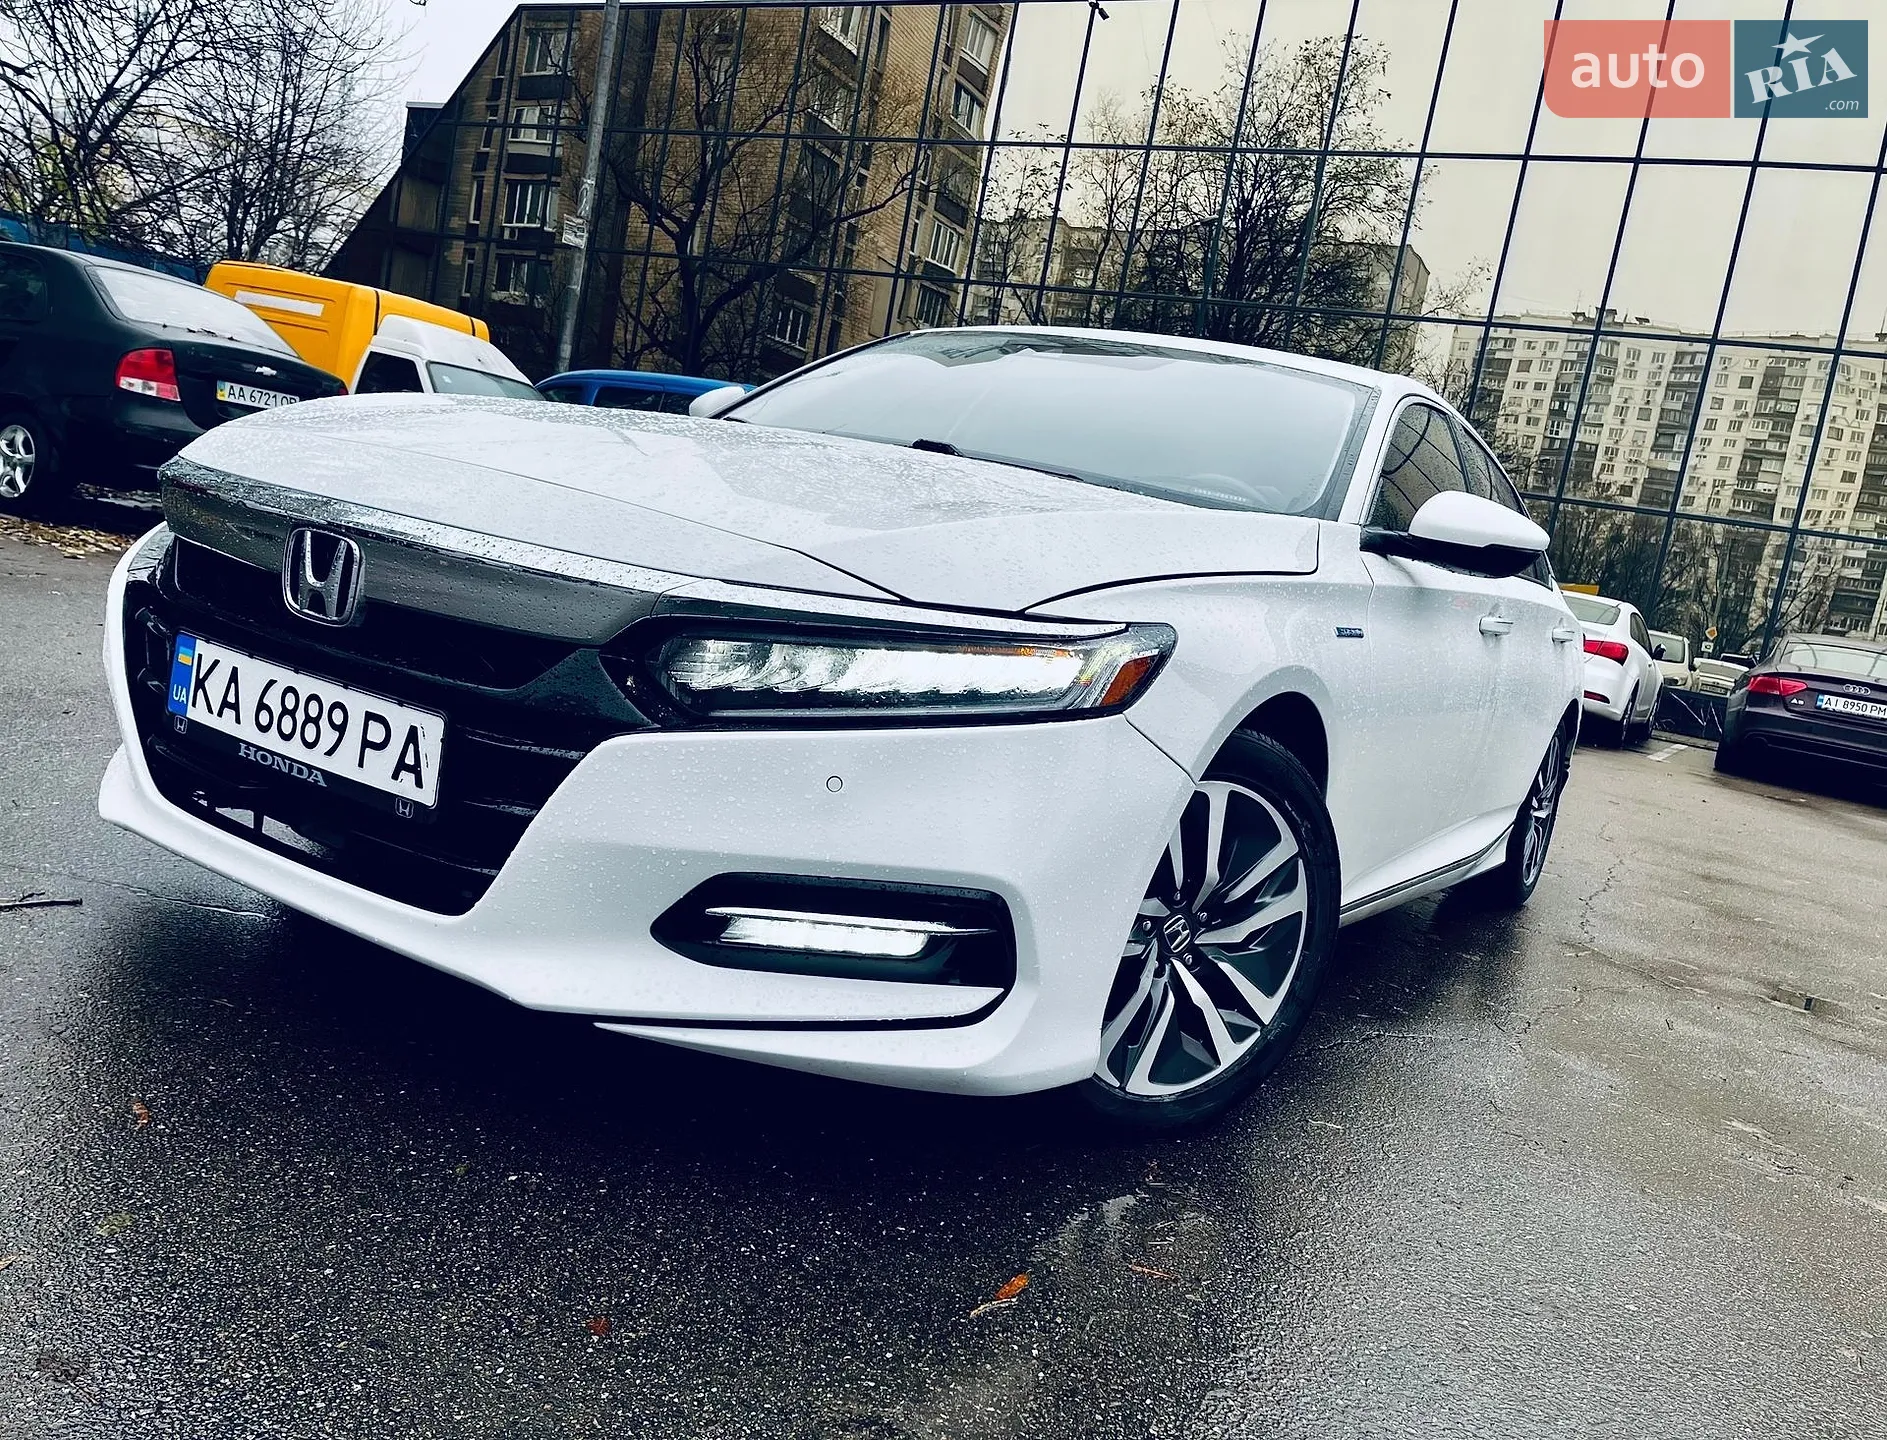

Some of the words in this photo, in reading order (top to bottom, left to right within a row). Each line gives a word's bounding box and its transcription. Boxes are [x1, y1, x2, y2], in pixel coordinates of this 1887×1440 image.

[227, 385, 246, 401] AA
[249, 389, 278, 407] 6721
[173, 684, 187, 705] UA
[1842, 700, 1868, 713] 8950
[1869, 705, 1887, 716] PM
[191, 653, 242, 725] KA
[254, 679, 349, 757] 6889
[357, 710, 424, 790] PA
[238, 742, 327, 787] HONDA
